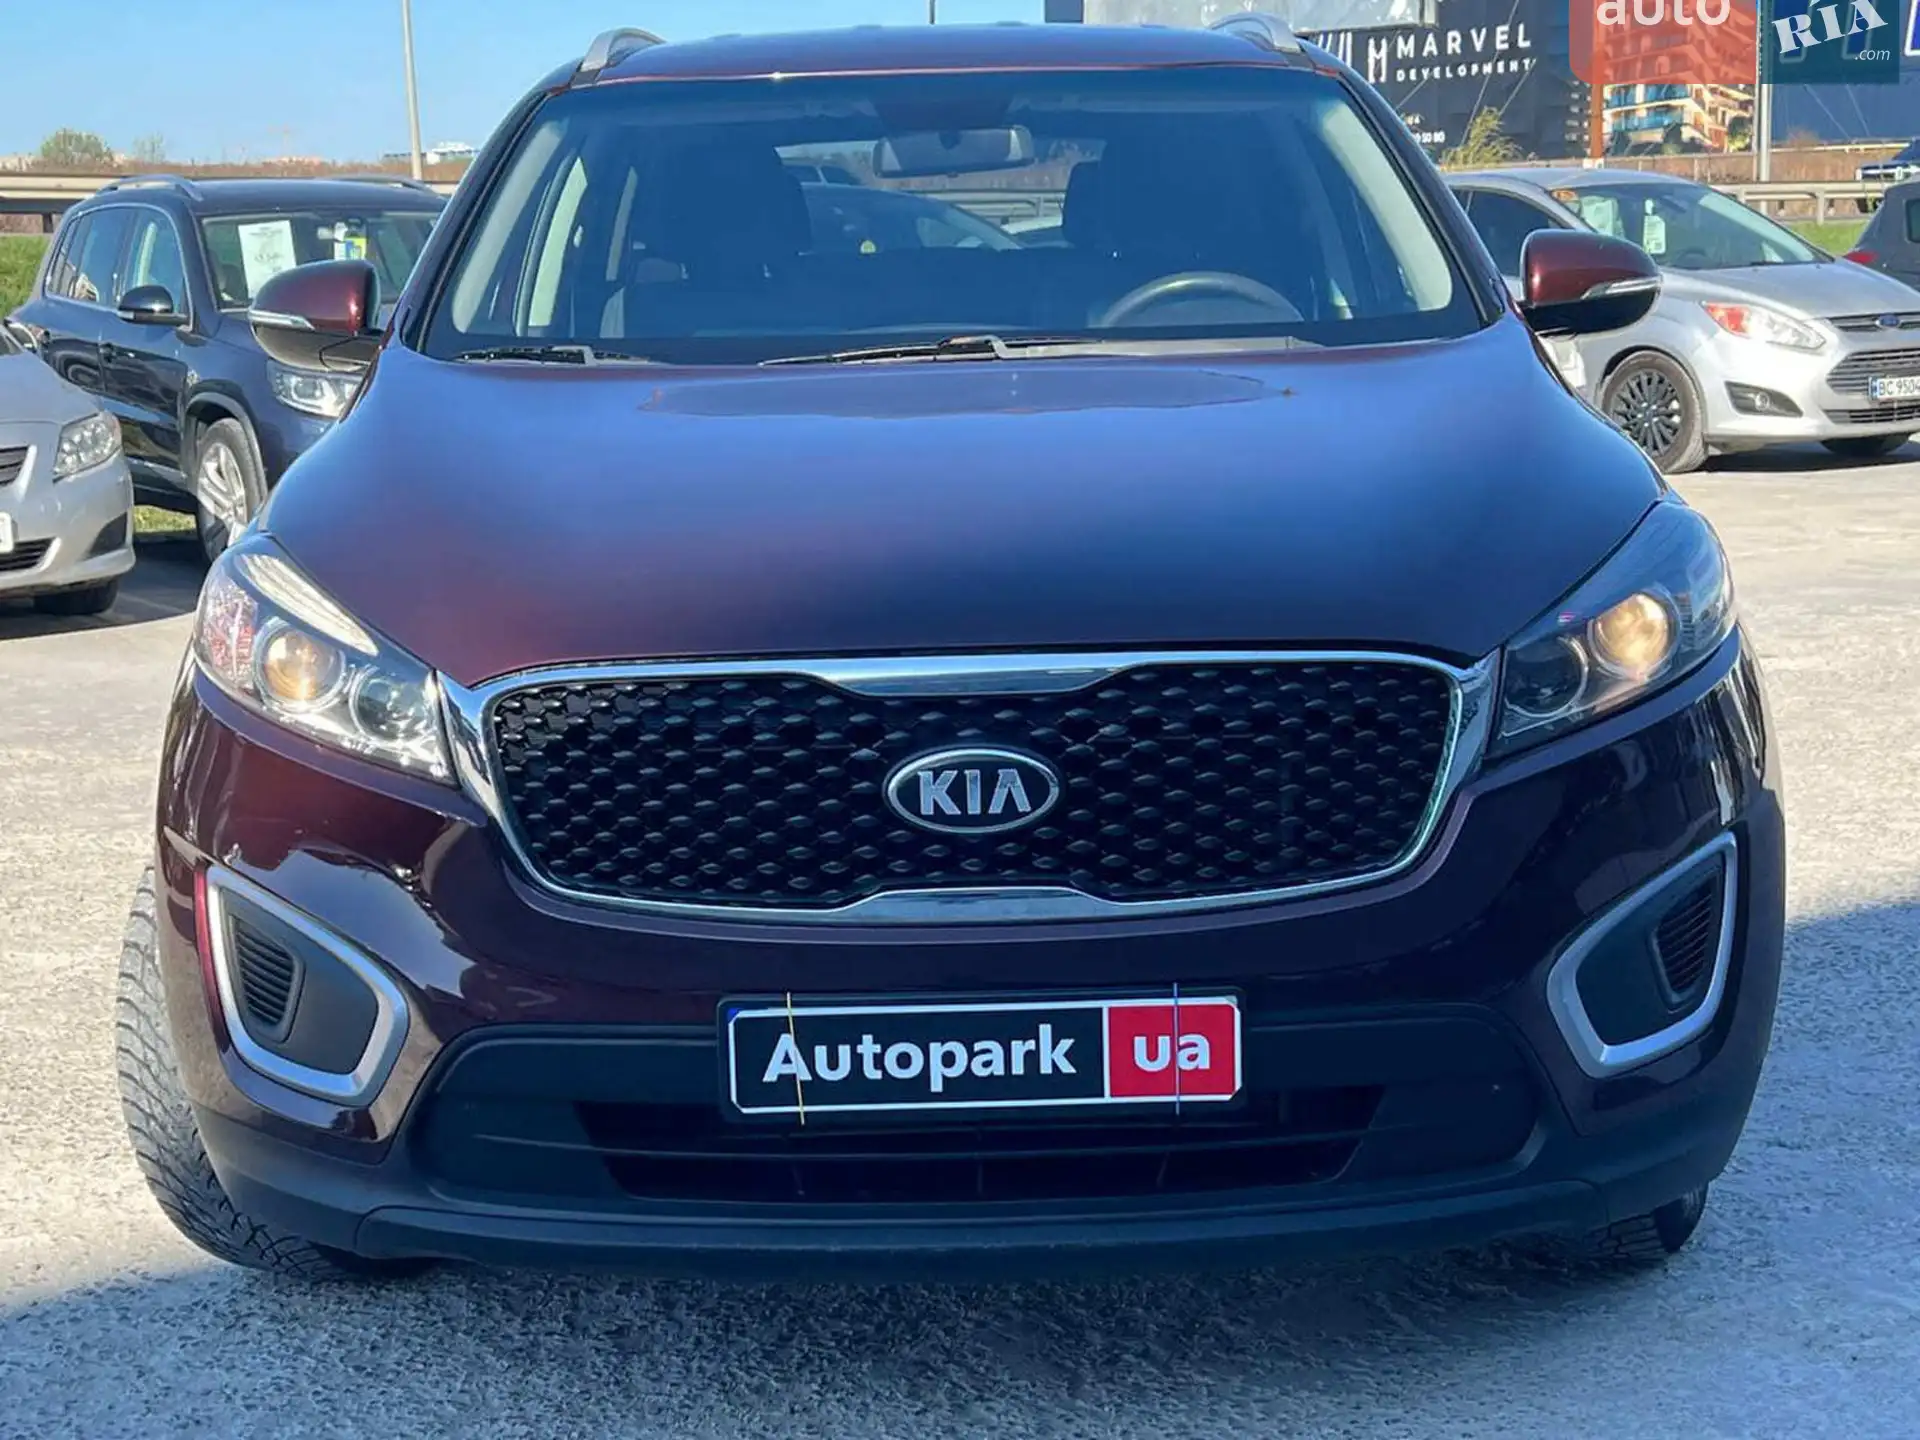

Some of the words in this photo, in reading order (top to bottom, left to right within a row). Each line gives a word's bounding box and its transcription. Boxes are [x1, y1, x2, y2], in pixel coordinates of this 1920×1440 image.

[1396, 23, 1532, 60] MARVEL
[1396, 57, 1532, 82] DEVELOPMENT
[917, 768, 1032, 816] KIA
[762, 1023, 1077, 1093] Autopark
[1132, 1031, 1212, 1072] ua
